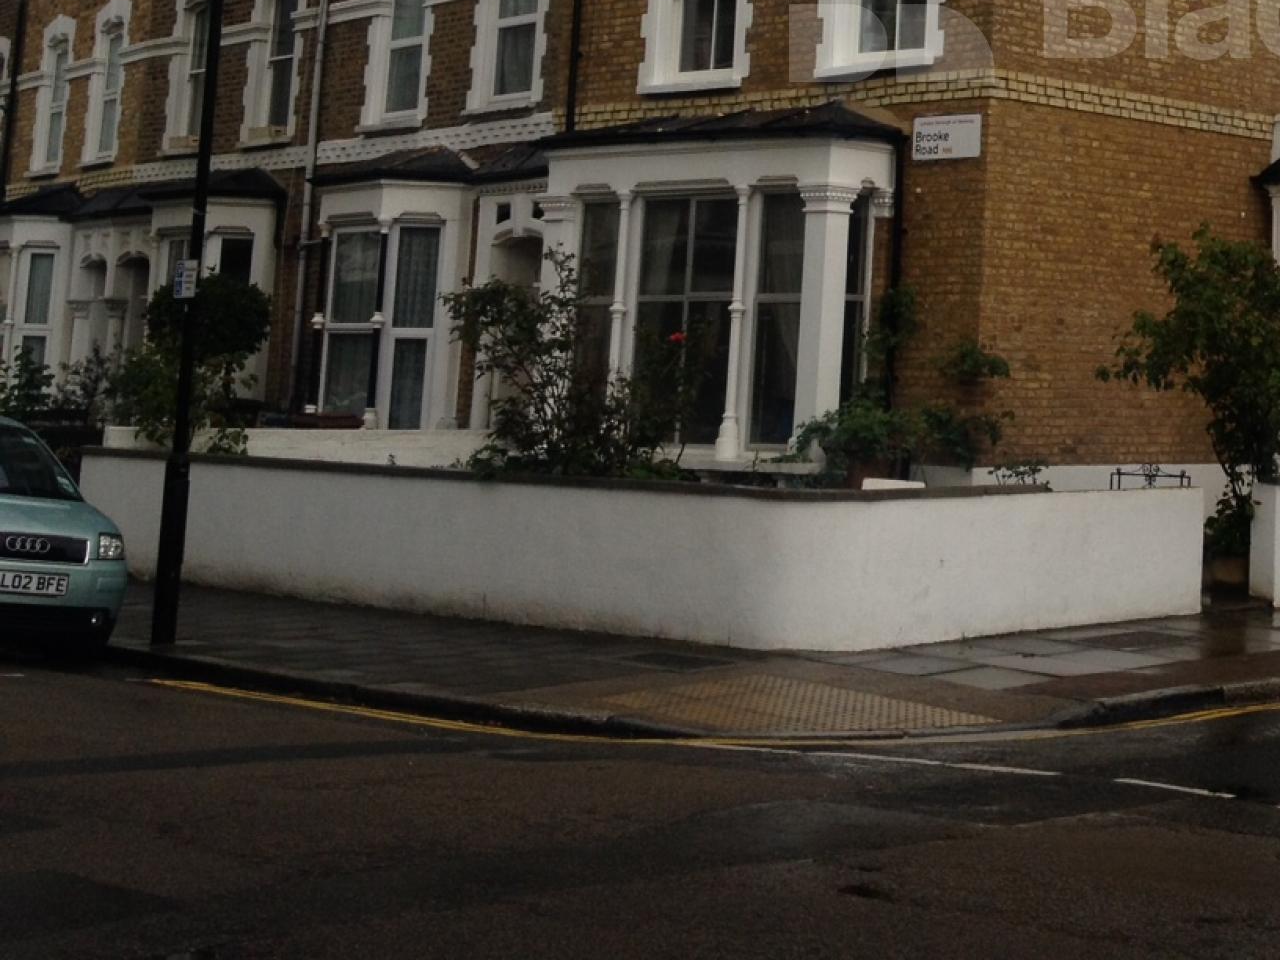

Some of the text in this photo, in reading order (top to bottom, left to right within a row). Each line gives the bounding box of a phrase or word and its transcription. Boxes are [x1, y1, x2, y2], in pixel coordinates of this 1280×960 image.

[916, 130, 950, 143] Brooke
[916, 144, 939, 156] Road
[36, 576, 66, 592] BFE
